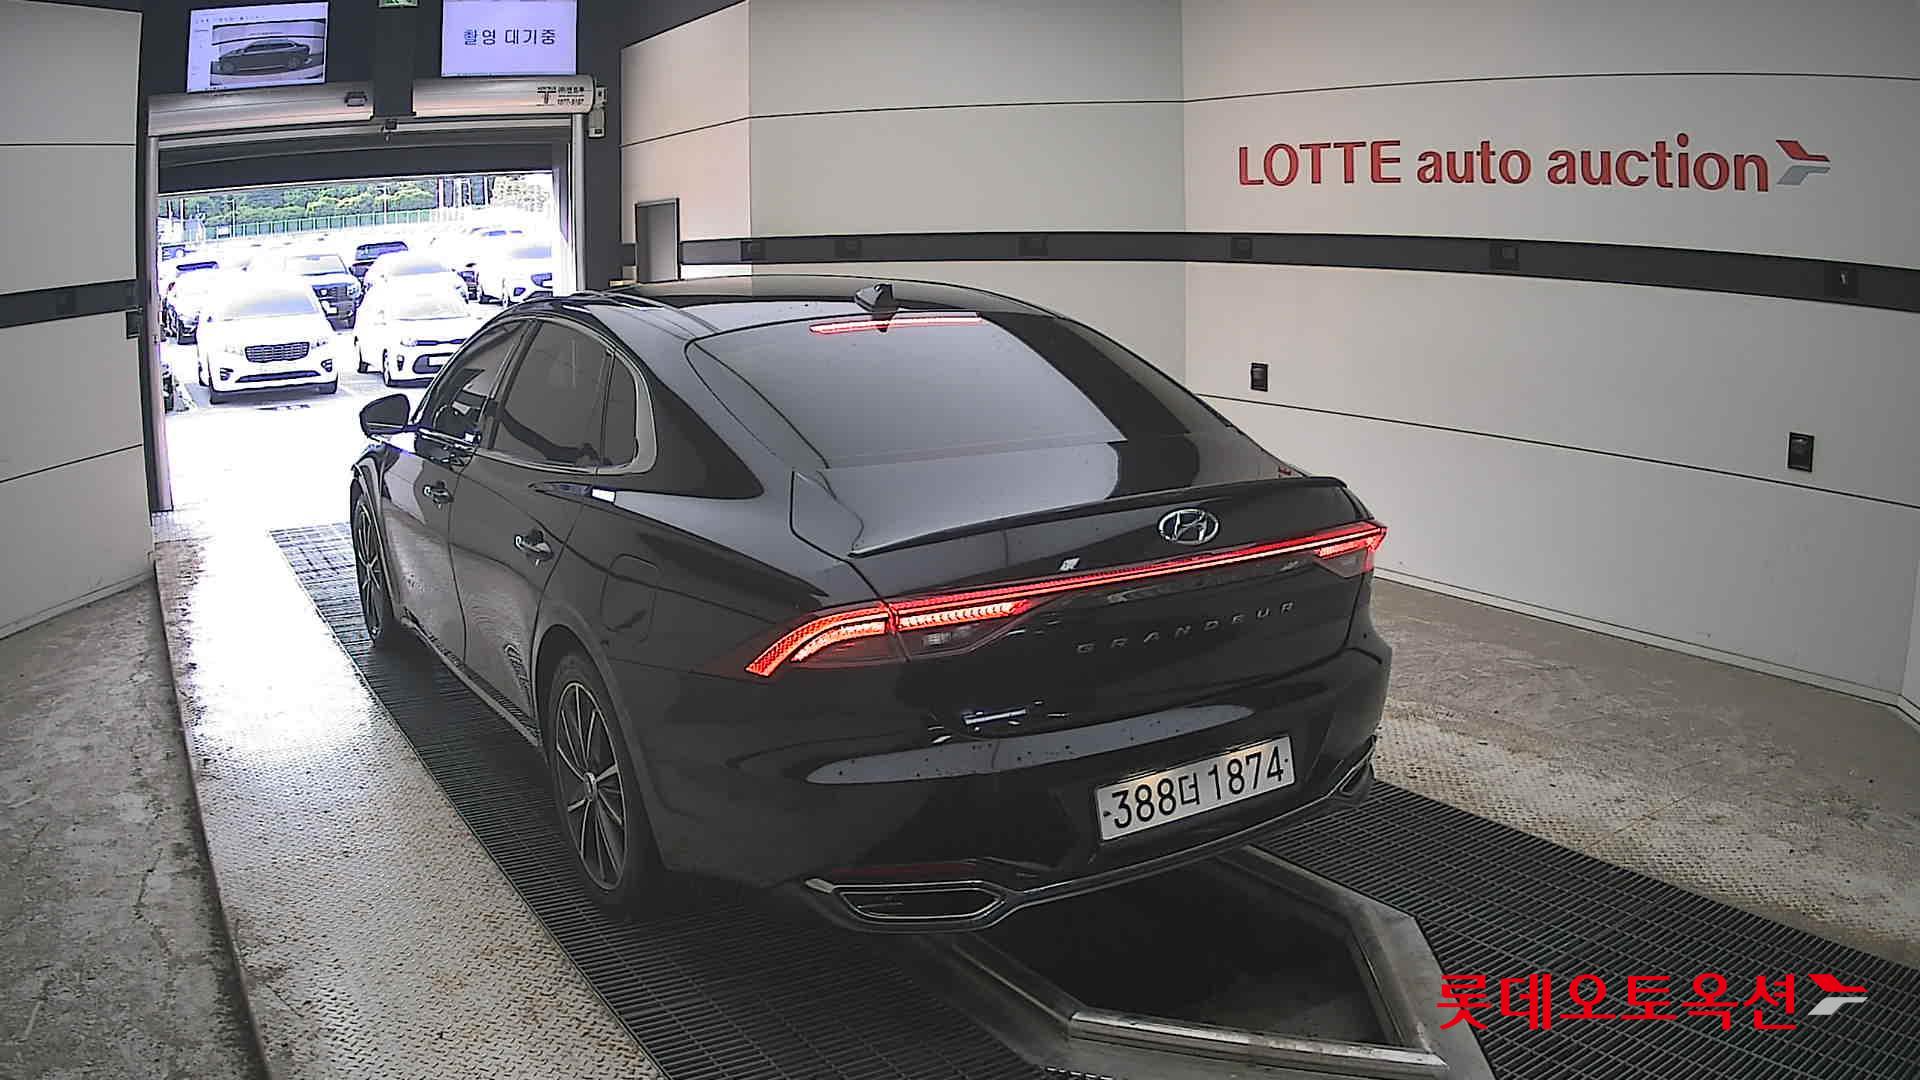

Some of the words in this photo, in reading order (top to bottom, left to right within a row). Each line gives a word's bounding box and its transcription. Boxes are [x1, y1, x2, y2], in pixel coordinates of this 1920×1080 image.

[504, 28, 556, 45] 대기중
[1239, 140, 1402, 187] LOTTE
[1416, 140, 1532, 185] auto
[1547, 133, 1770, 193] auction
[1076, 601, 1294, 654] GRANDEUR
[1111, 772, 1201, 829] 388더
[1207, 745, 1285, 801] 1874
